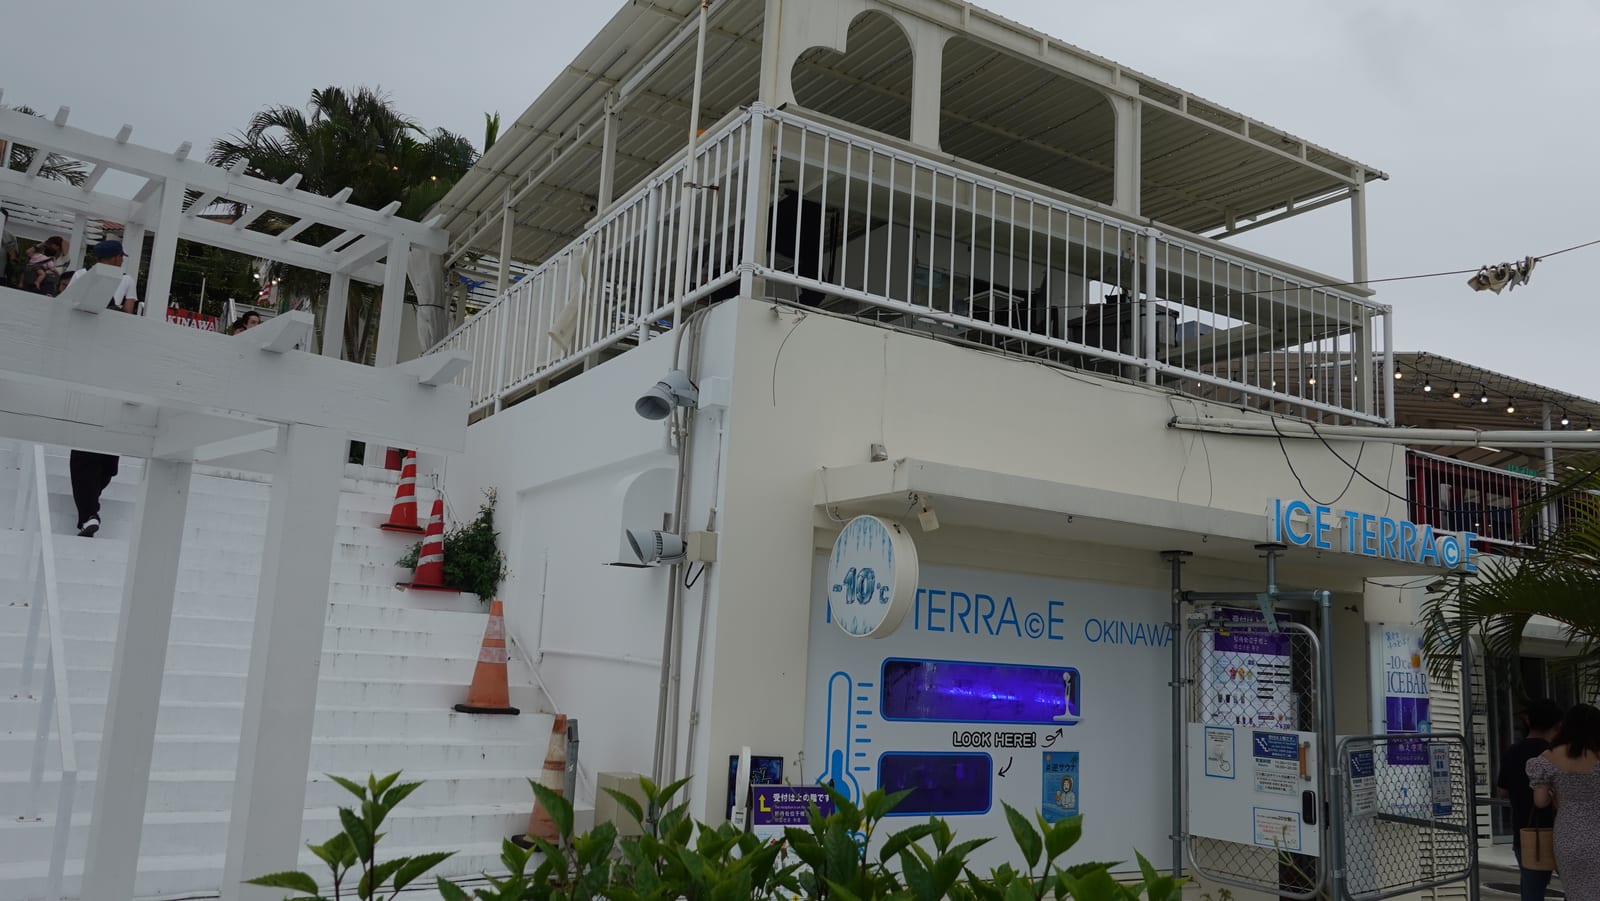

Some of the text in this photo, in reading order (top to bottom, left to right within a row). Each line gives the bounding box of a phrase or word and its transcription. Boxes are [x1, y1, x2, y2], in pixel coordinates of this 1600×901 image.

[167, 315, 217, 332] KINAWA
[1275, 498, 1332, 549] ICE
[1084, 618, 1175, 648] OKINAWA
[953, 731, 1037, 748] LOOK HERE!
